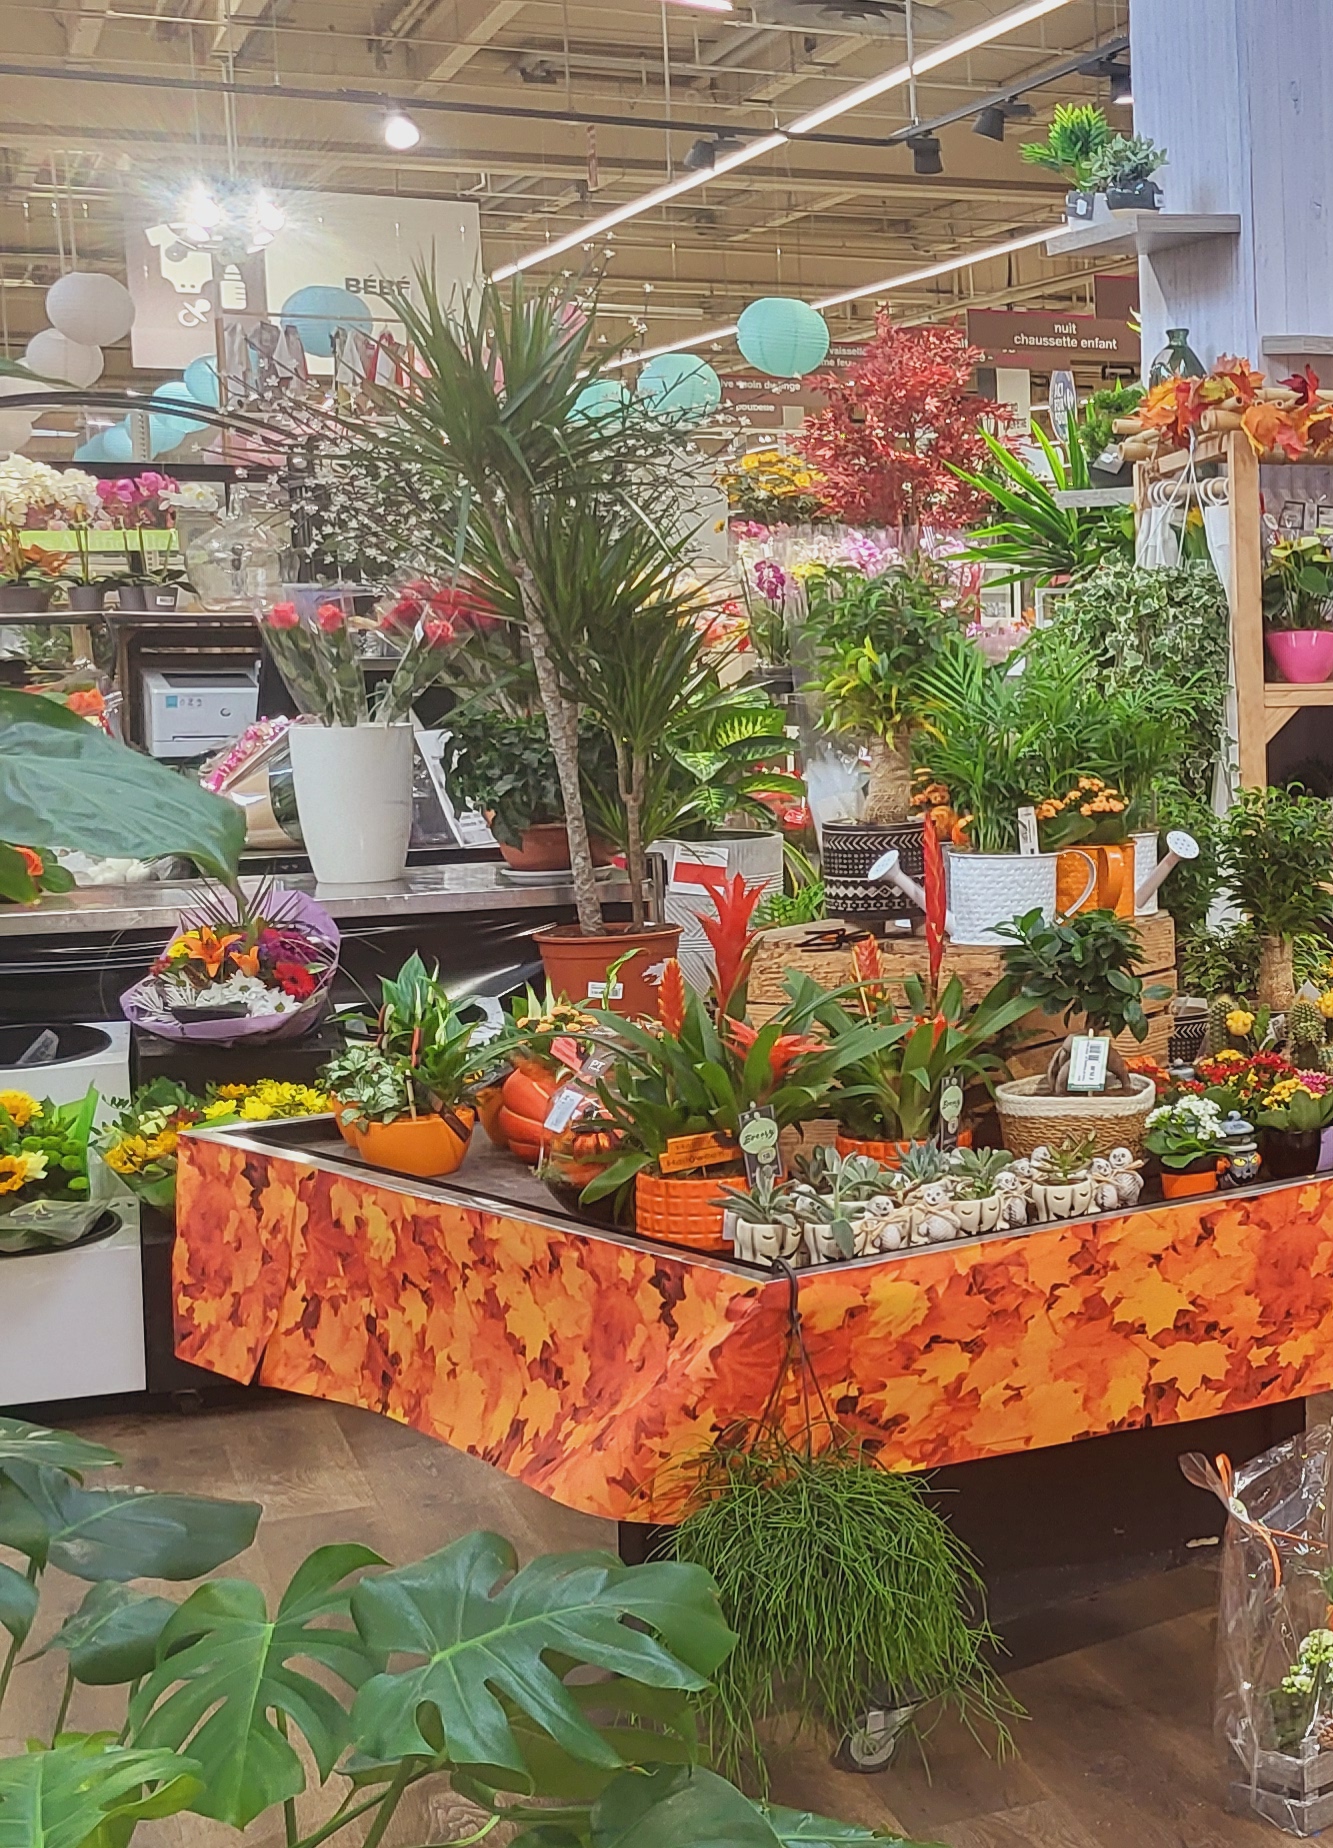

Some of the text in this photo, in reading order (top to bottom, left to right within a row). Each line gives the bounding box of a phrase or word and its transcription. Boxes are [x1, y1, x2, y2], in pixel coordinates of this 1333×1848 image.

[345, 274, 410, 296] BÉBÉ
[1054, 322, 1077, 334] nuit
[1014, 333, 1117, 350] chaussette enfant
